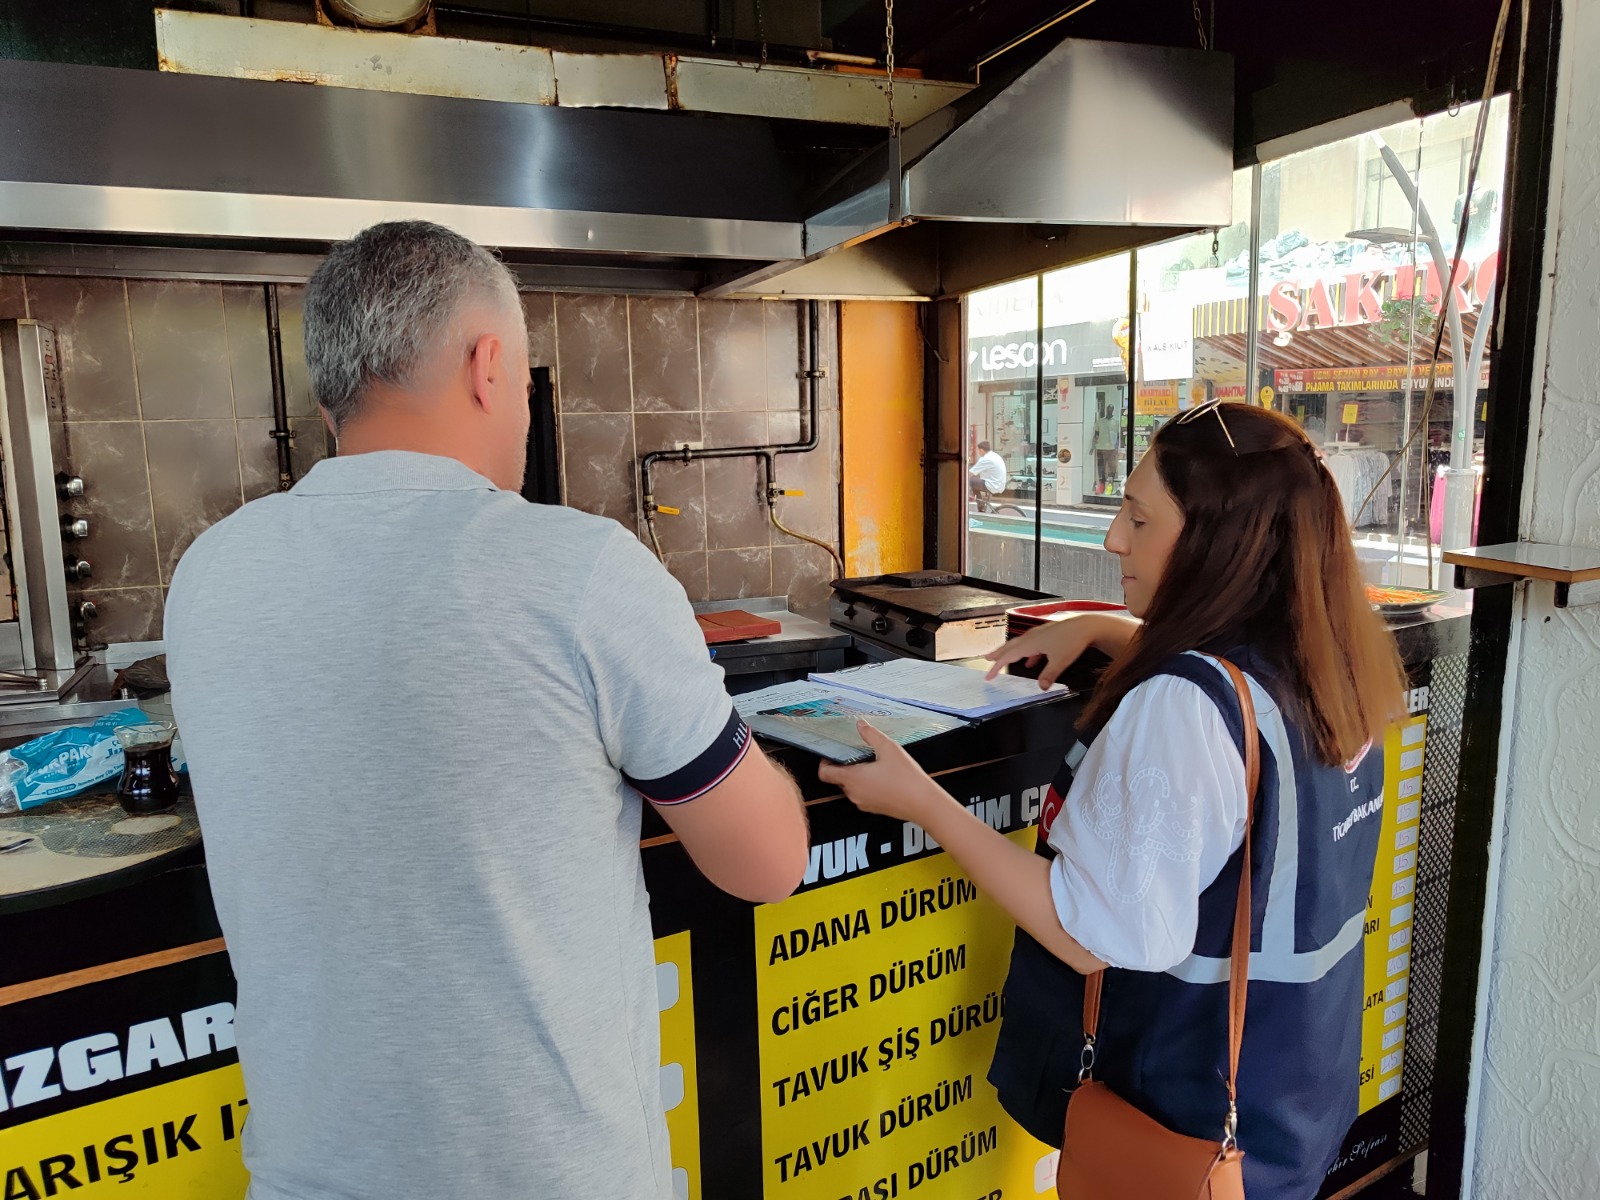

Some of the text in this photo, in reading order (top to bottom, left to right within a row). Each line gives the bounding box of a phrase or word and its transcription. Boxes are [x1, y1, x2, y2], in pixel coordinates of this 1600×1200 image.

[1337, 379, 1399, 392] TAKIMLARINDA
[769, 877, 978, 966] ADANA DÜRÜM
[771, 943, 967, 1037] CİĞER DÜRÜM
[772, 1046, 869, 1108] TAVUK
[877, 1027, 920, 1072] ŞİŞ
[774, 1074, 973, 1183] TAVUK DÜRÜM
[908, 1125, 997, 1190] DÜRÜM
